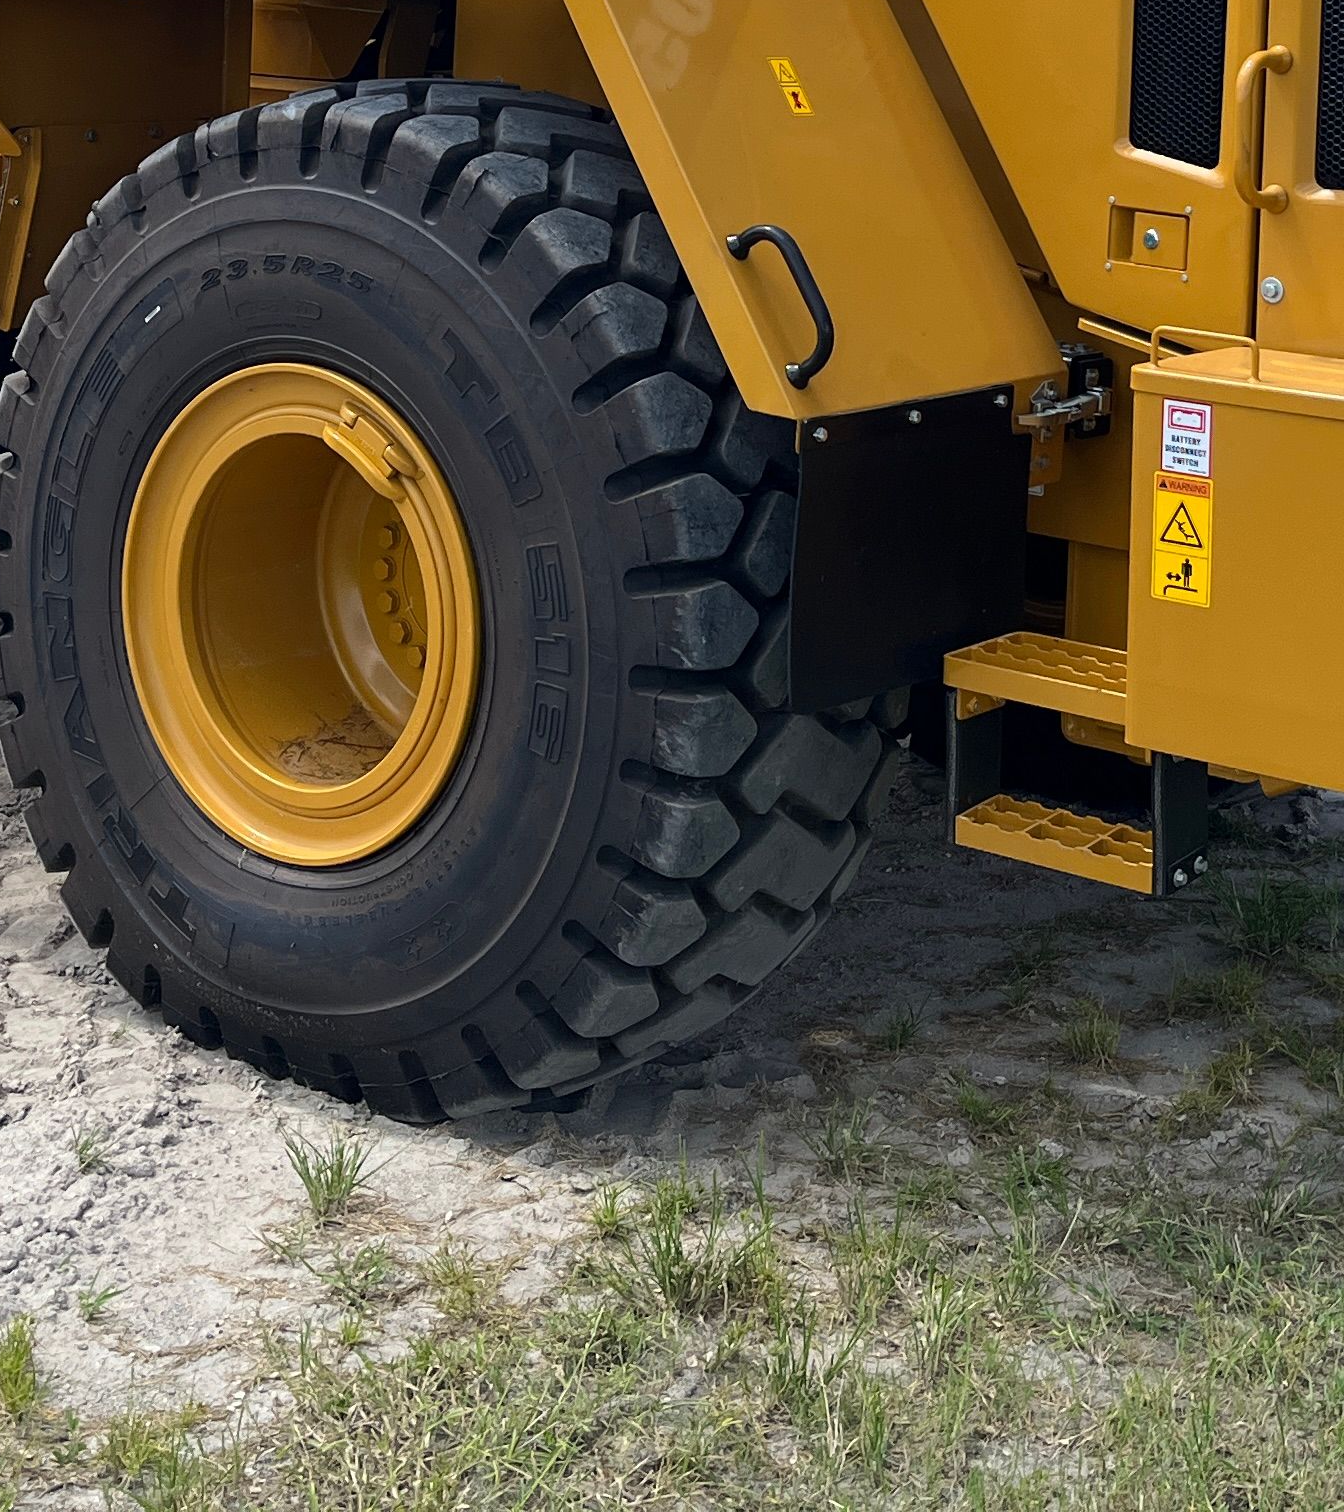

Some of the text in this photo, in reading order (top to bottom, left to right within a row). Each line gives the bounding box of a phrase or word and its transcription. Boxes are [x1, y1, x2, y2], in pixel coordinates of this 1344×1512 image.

[199, 252, 375, 295] 23.5R25
[1171, 434, 1201, 445] BATTERY
[1172, 456, 1199, 467] SWITCH
[1168, 479, 1208, 495] WARNING
[441, 327, 572, 765] TB 516
[42, 348, 197, 942] TRIANGLE
